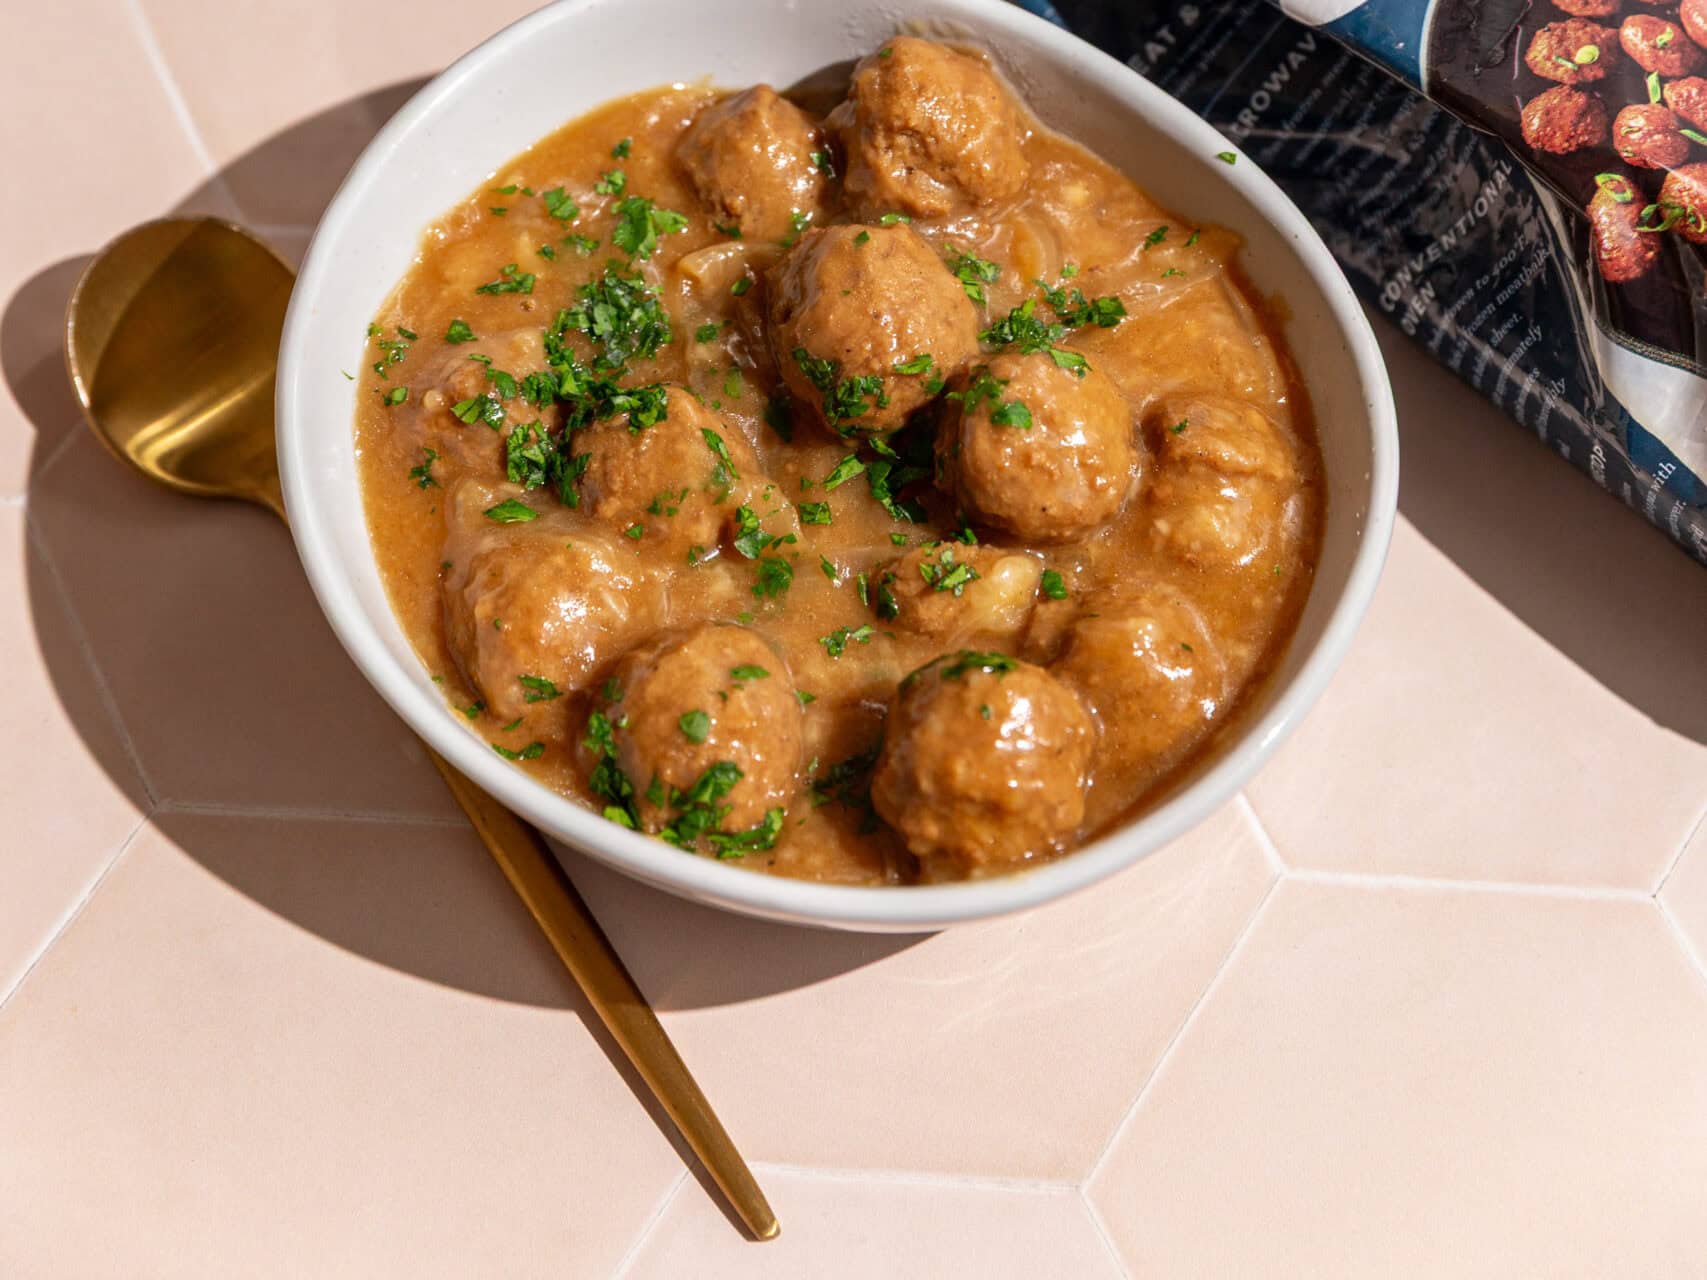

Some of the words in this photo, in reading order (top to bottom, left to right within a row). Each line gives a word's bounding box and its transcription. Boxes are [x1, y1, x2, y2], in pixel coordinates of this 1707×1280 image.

[1379, 160, 1513, 312] CONVENTIONAL
[1402, 281, 1436, 336] OVEN
[1651, 460, 1676, 493] with
